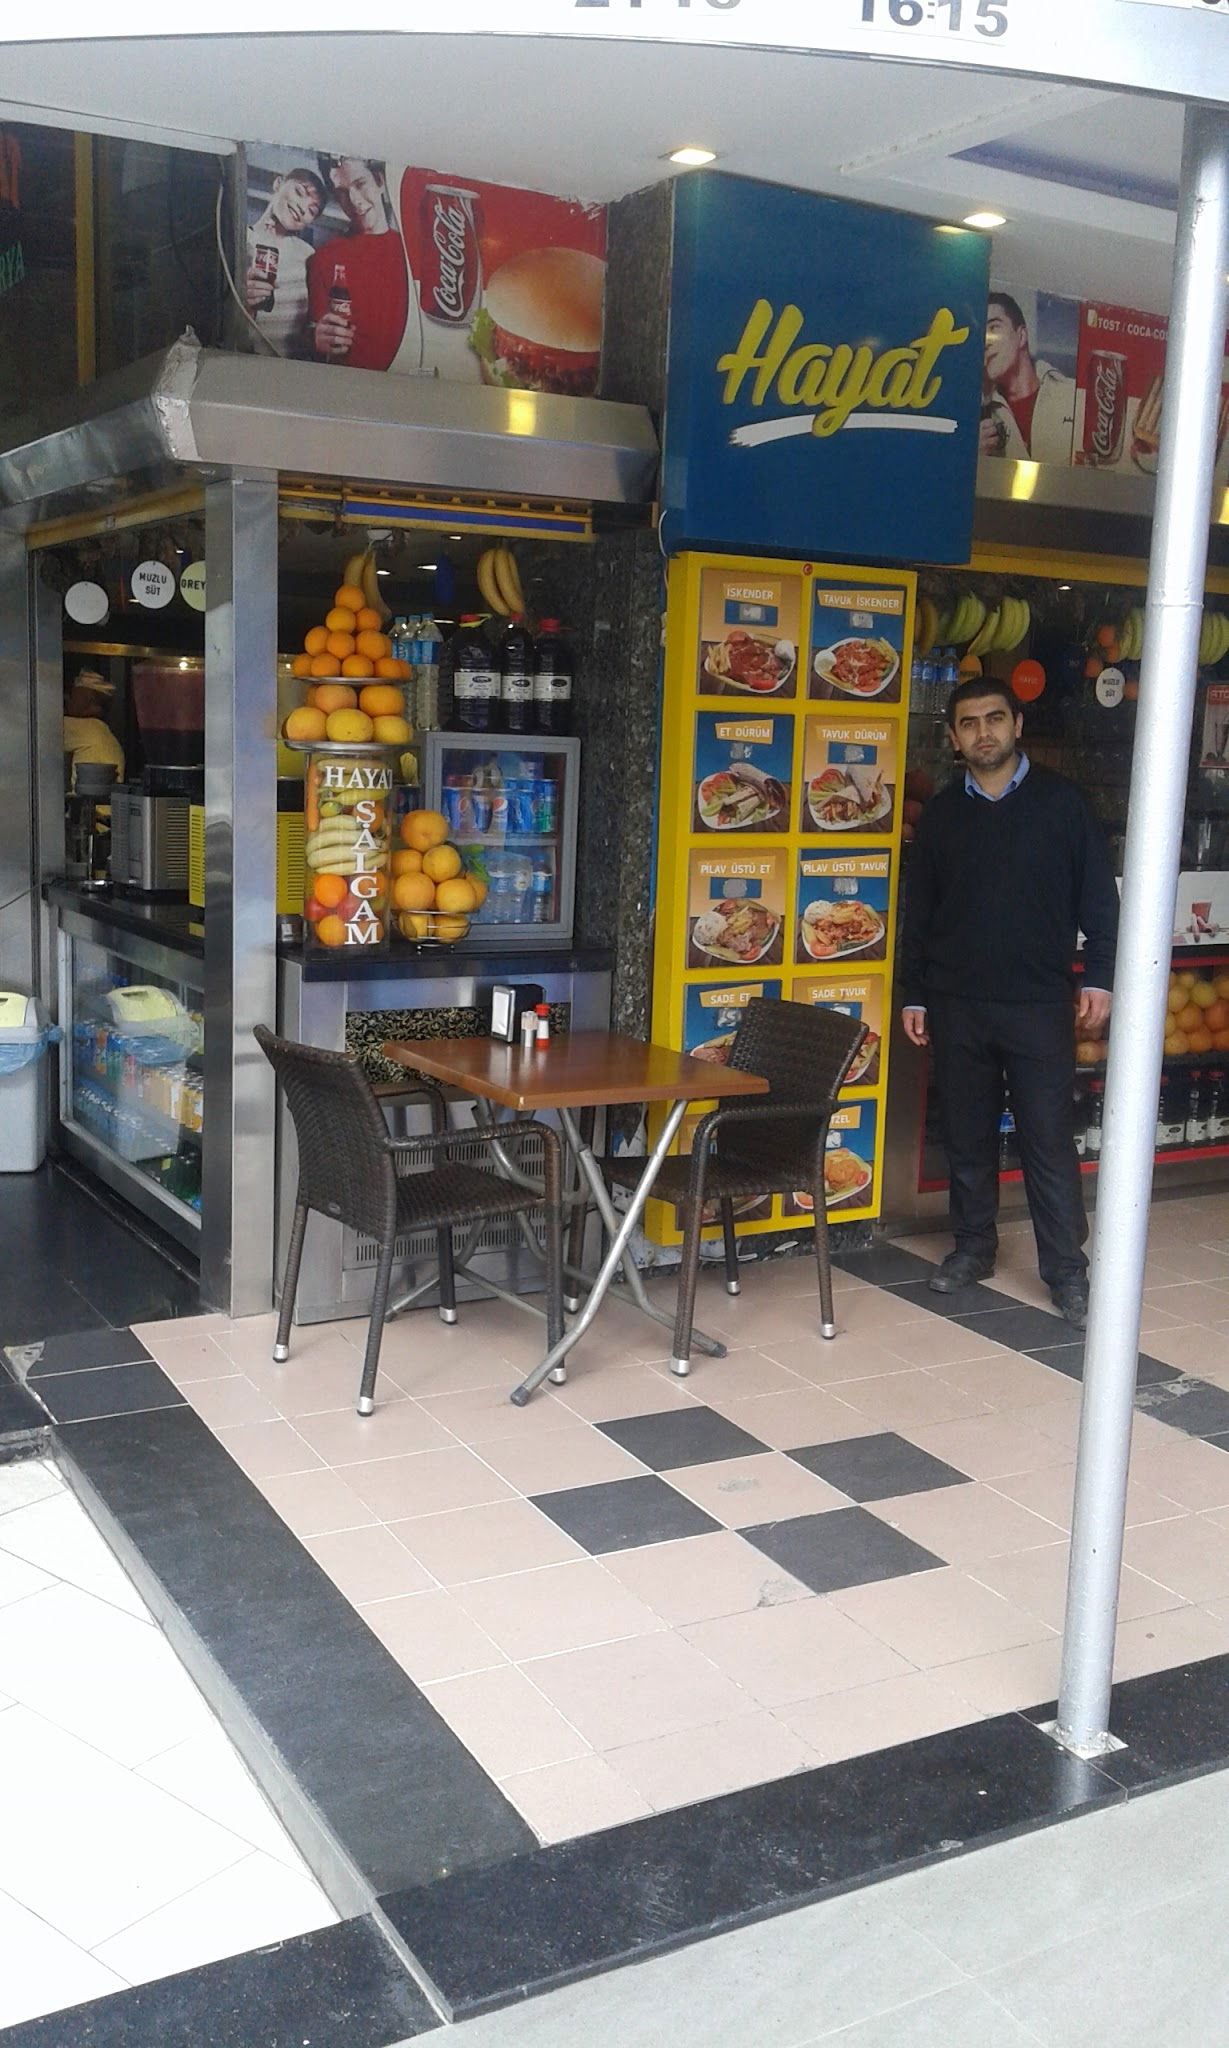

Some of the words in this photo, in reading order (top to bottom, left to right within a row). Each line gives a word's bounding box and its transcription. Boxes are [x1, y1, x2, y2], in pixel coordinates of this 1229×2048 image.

[1097, 317, 1121, 332] TOST
[717, 299, 969, 437] Hayat
[139, 572, 167, 584] MUZLU
[145, 585, 160, 596] SÜT
[726, 585, 774, 601] İSKENDER
[824, 594, 852, 605] TAVUK
[856, 594, 900, 609] İSKENDER
[719, 726, 732, 737] ET
[735, 726, 770, 738] DÜRÜM
[822, 728, 850, 739] TAVUK
[855, 728, 887, 741] DÜRÜM
[700, 863, 727, 874] PİLAV
[731, 863, 756, 874] ÜSTÜ
[760, 864, 772, 874] ET
[803, 861, 828, 873] PİLAV
[832, 860, 856, 872] ÜSTÜ
[860, 861, 888, 871] TAVUK
[710, 994, 735, 1004] SADE
[739, 993, 751, 1003] ET
[812, 988, 836, 999] SADE
